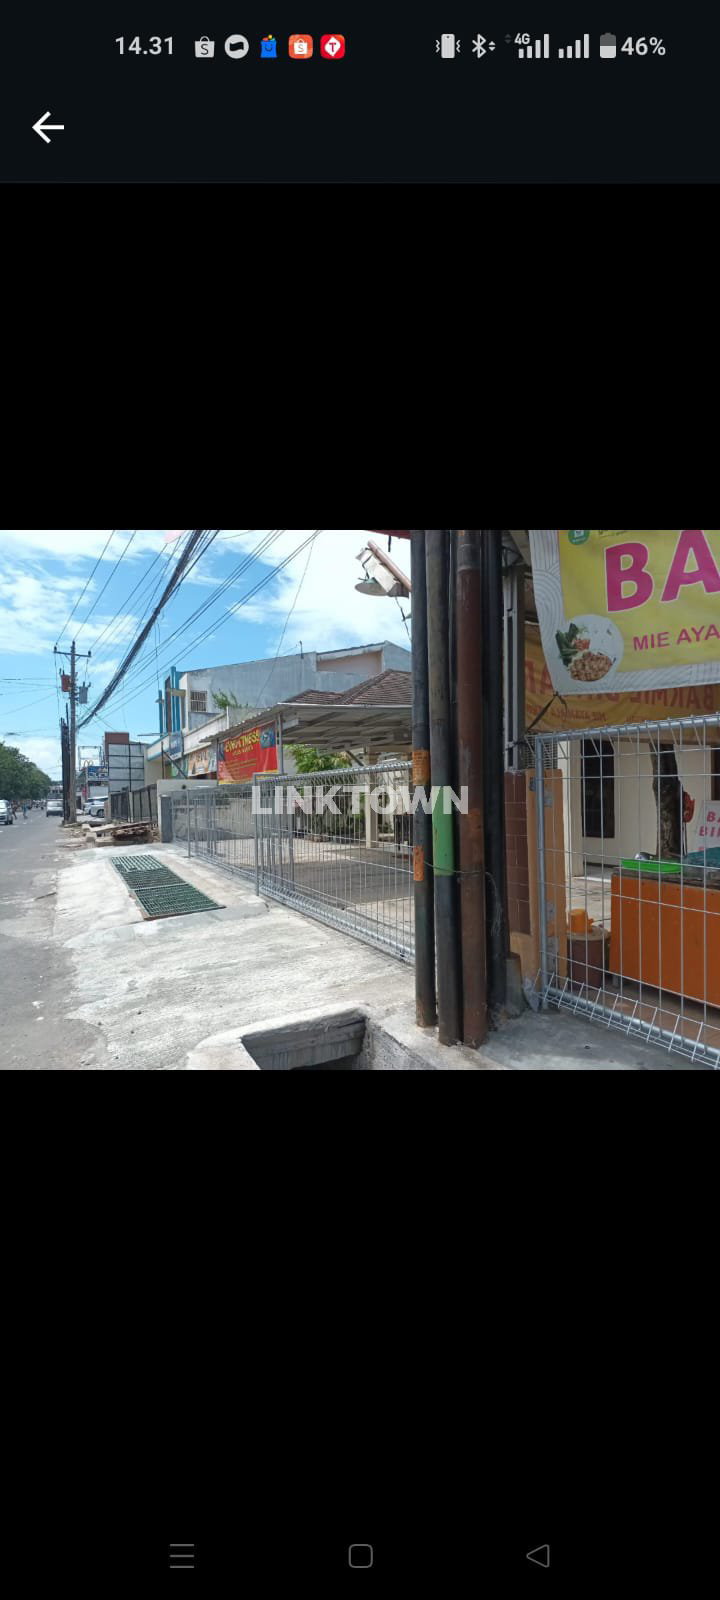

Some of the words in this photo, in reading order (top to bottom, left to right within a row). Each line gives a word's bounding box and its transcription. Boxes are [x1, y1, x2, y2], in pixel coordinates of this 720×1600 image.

[633, 632, 670, 651] MIE
[676, 624, 720, 645] AYA
[706, 811, 720, 823] B
[699, 825, 720, 837] BI
